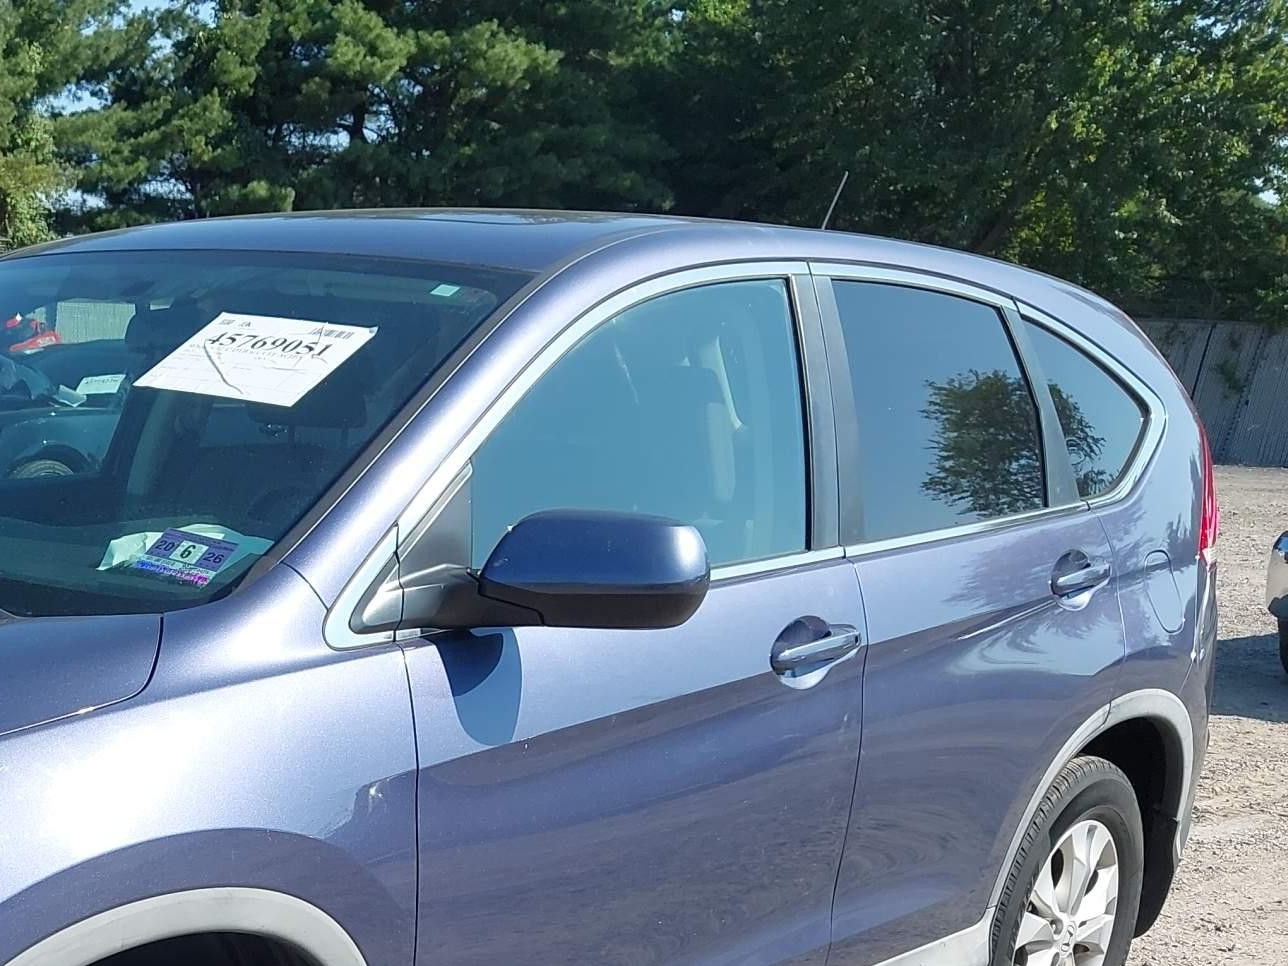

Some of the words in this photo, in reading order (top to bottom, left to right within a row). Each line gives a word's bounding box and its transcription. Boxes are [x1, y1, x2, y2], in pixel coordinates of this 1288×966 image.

[207, 331, 334, 358] 45769051
[155, 540, 175, 552] 20
[179, 544, 196, 559] 6
[202, 552, 225, 564] 26
